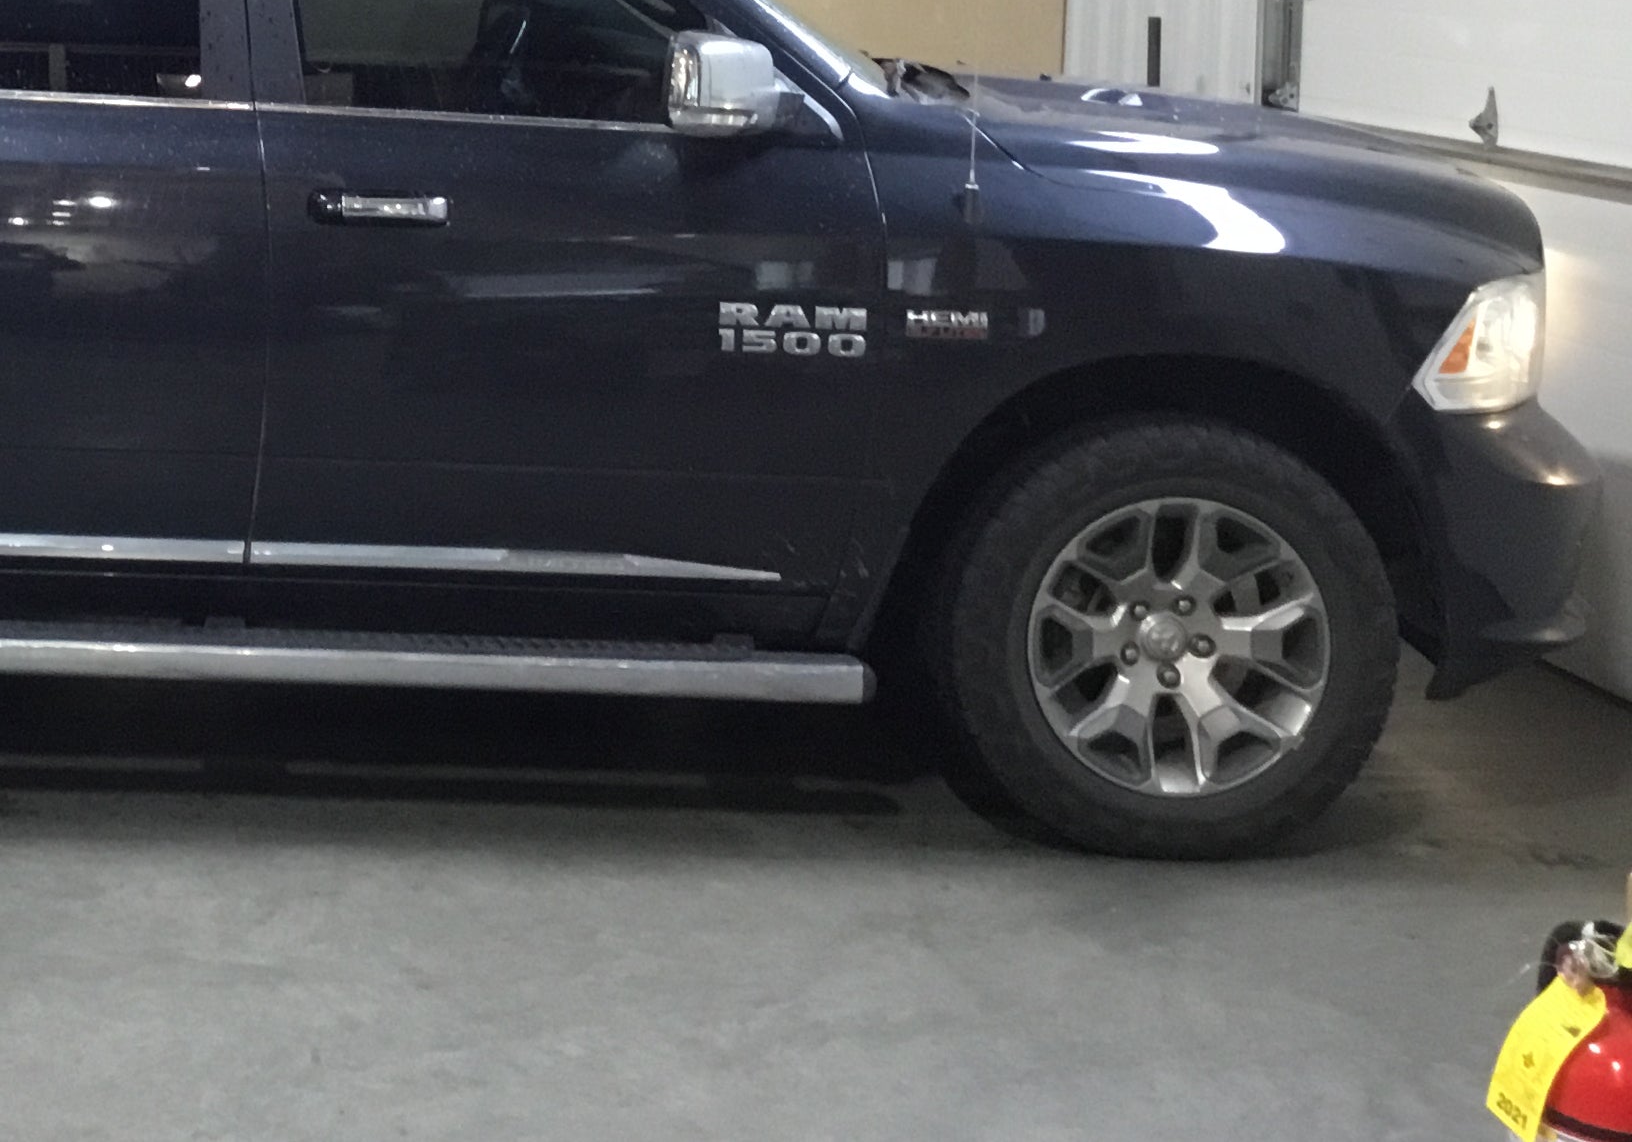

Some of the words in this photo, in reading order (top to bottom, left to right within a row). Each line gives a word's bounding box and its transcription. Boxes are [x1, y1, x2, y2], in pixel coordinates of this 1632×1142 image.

[719, 302, 867, 331] RAM
[906, 309, 988, 329] HEMI
[718, 328, 867, 357] 1500
[1496, 1092, 1528, 1130] 2021
